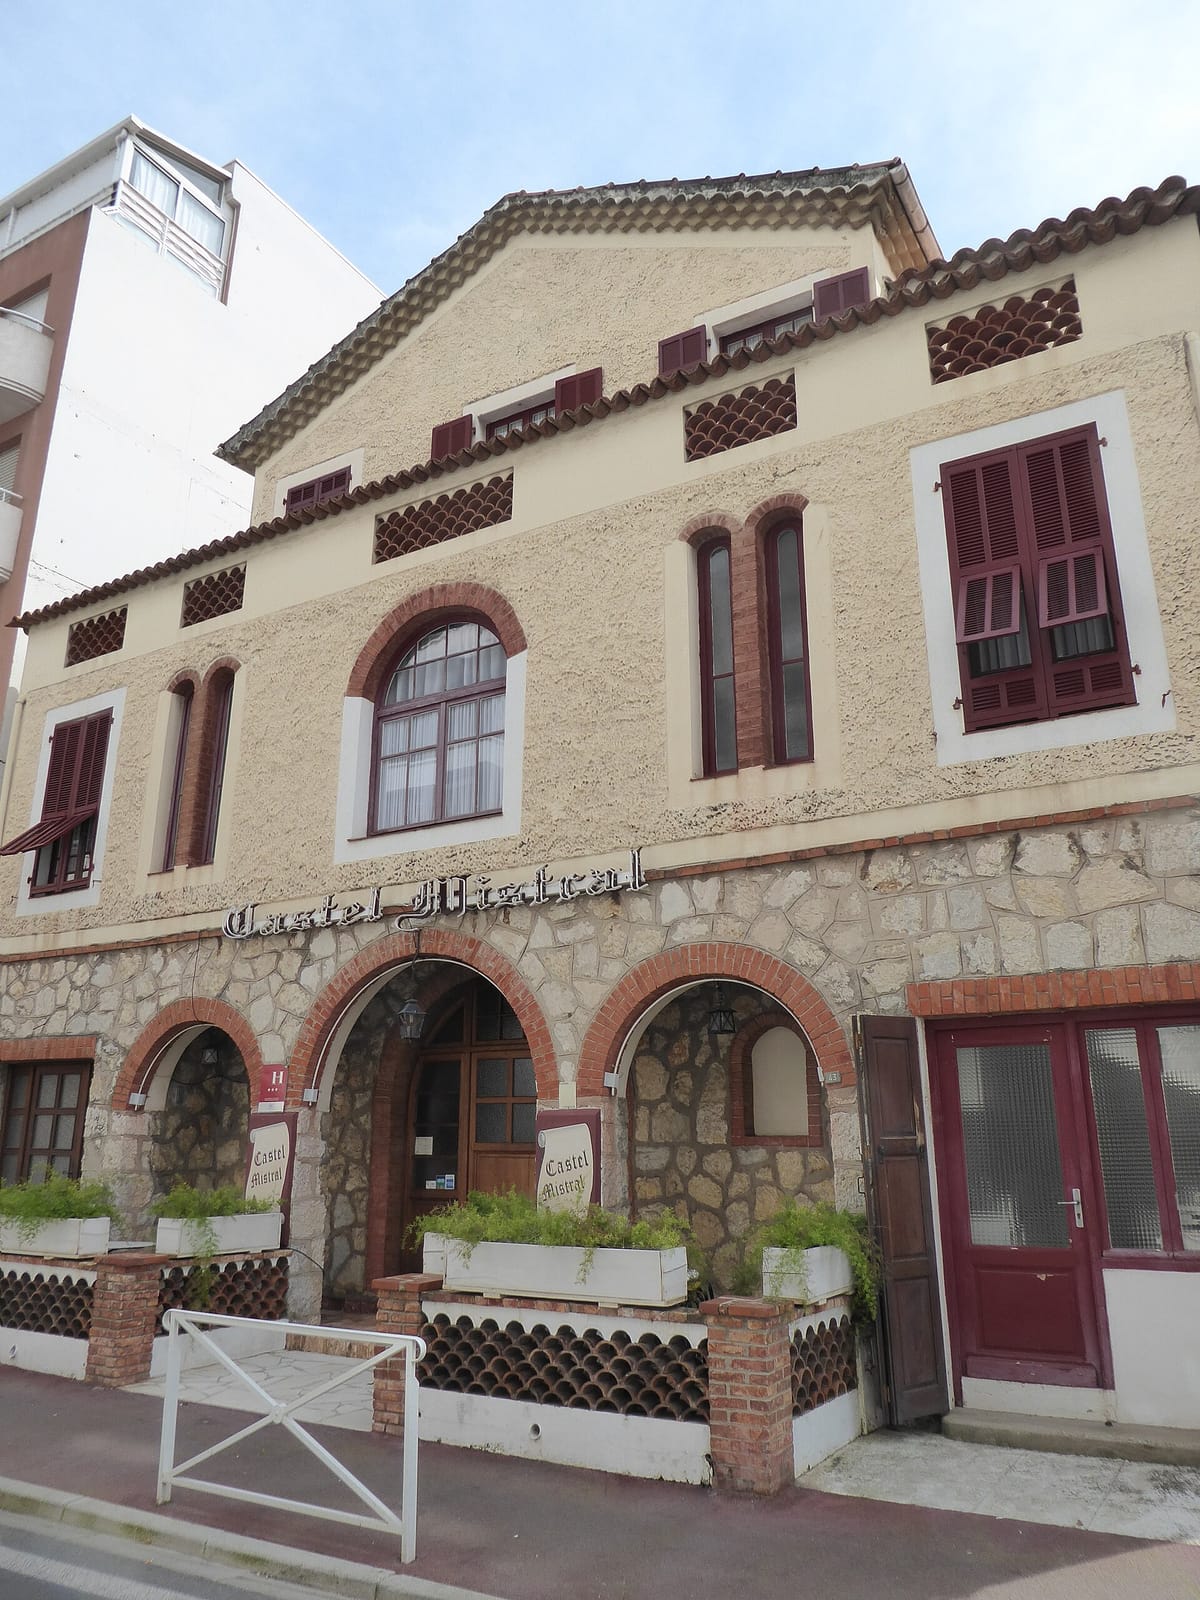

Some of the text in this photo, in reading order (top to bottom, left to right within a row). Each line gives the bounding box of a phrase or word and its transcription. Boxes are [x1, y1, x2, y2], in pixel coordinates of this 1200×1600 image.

[222, 847, 649, 939] Castel Mistral
[272, 1071, 284, 1084] H
[254, 1144, 286, 1167] Castel
[545, 1150, 589, 1177] Castel
[251, 1167, 283, 1189] Mistral
[539, 1175, 585, 1202] Mistral
